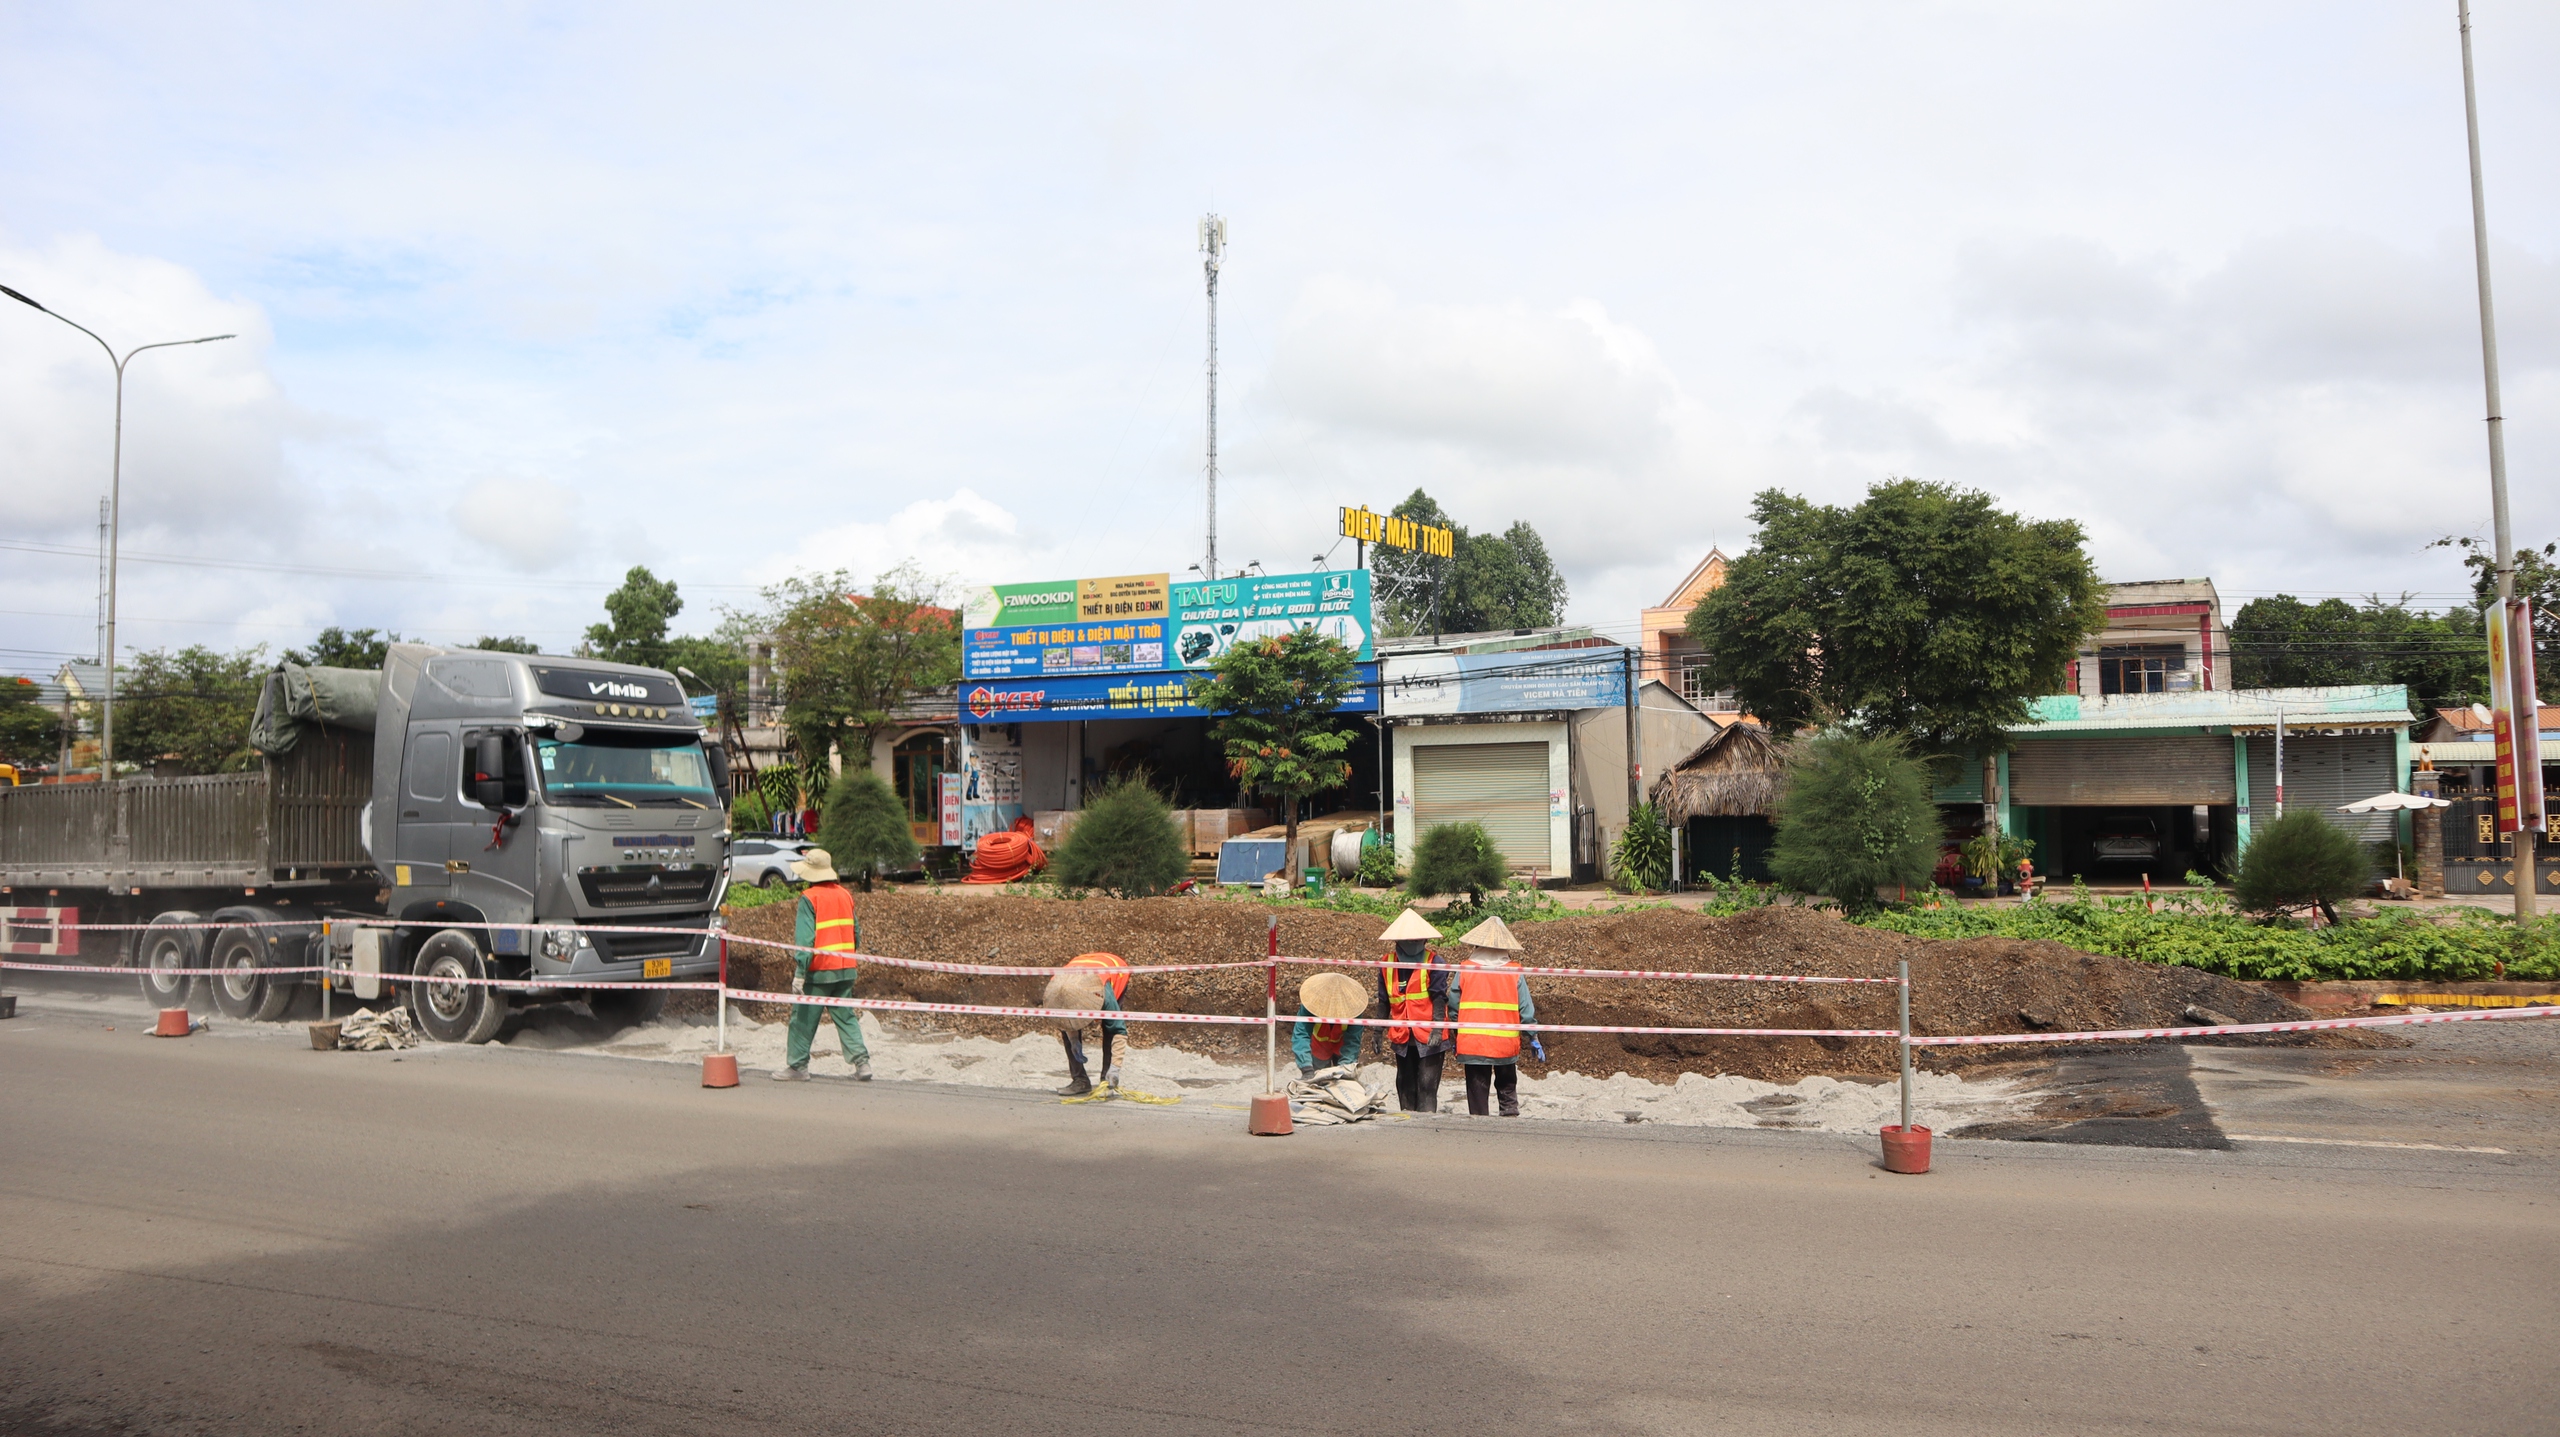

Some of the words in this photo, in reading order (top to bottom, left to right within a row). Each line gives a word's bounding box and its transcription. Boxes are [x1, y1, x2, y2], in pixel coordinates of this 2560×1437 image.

[1344, 504, 1381, 546] ĐIỆN
[1386, 514, 1419, 554] MẶT
[1422, 523, 1454, 559] TRỜI
[1003, 591, 1075, 607] FAWOOKIDI
[1083, 600, 1103, 616] THIẾT
[1106, 603, 1113, 616] BỊ
[1114, 600, 1133, 615] ĐIỆN
[1136, 600, 1163, 612] EDENKI
[1181, 608, 1219, 622] CHUYÊN
[1222, 608, 1240, 620] GIA
[1257, 603, 1285, 617] MÁY
[1318, 598, 1352, 613] NƯỚC
[1010, 628, 1037, 646] THIẾT
[1038, 631, 1049, 647] BỊ
[1052, 628, 1075, 646] ĐIỆN
[1078, 629, 1086, 642] &
[1087, 626, 1112, 644] ĐIỆN
[1114, 624, 1136, 642] MẶT
[1138, 622, 1162, 639] TRỜI
[1558, 680, 1570, 688] CÁC
[993, 689, 1046, 712] SGES
[1051, 698, 1105, 712] SHOWROOM
[1108, 680, 1139, 710] THIẾT
[1141, 685, 1154, 713] BỊ
[1156, 680, 1183, 712] ĐIỆN
[1523, 690, 1551, 700] VICEM
[1552, 688, 1566, 698] HÀ
[1566, 687, 1588, 698] TIÊN
[944, 792, 960, 808] ĐIỆN
[652, 960, 664, 969] 93H
